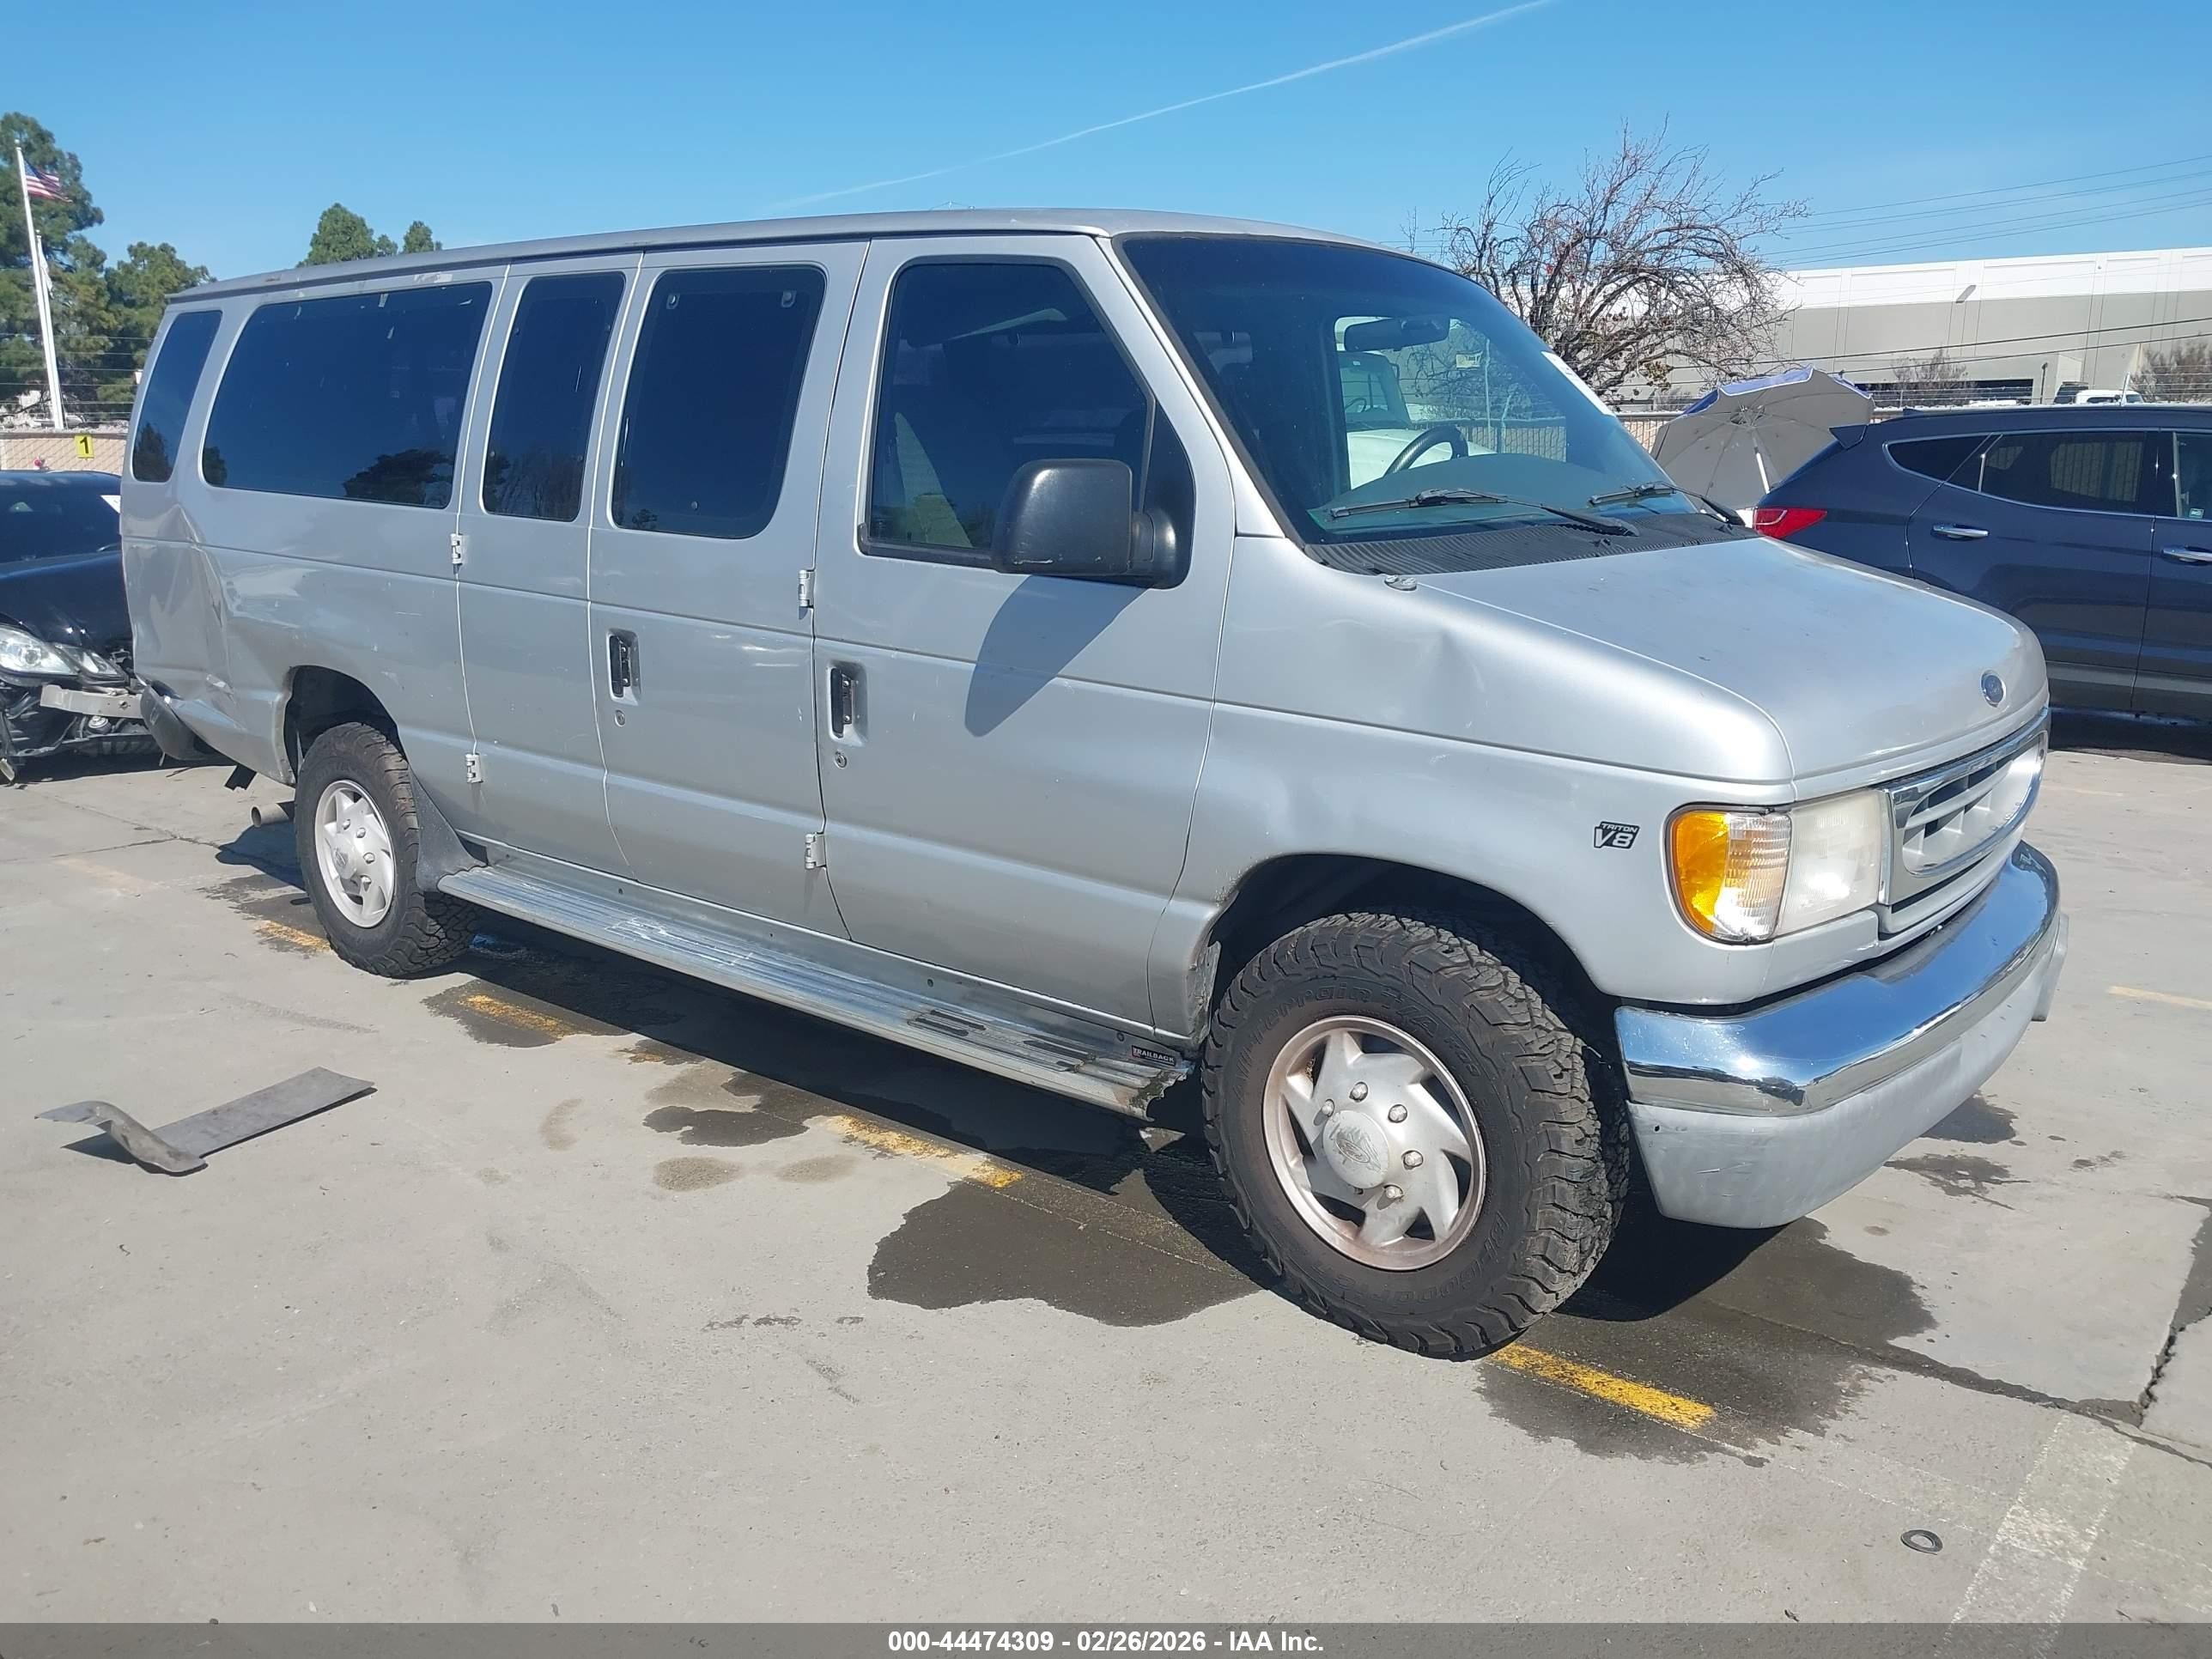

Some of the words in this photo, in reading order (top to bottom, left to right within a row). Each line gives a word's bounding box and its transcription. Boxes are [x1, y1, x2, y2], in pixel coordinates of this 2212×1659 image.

[80, 436, 89, 453] 1
[1601, 823, 1638, 833] TRITON
[1595, 828, 1634, 848] V8
